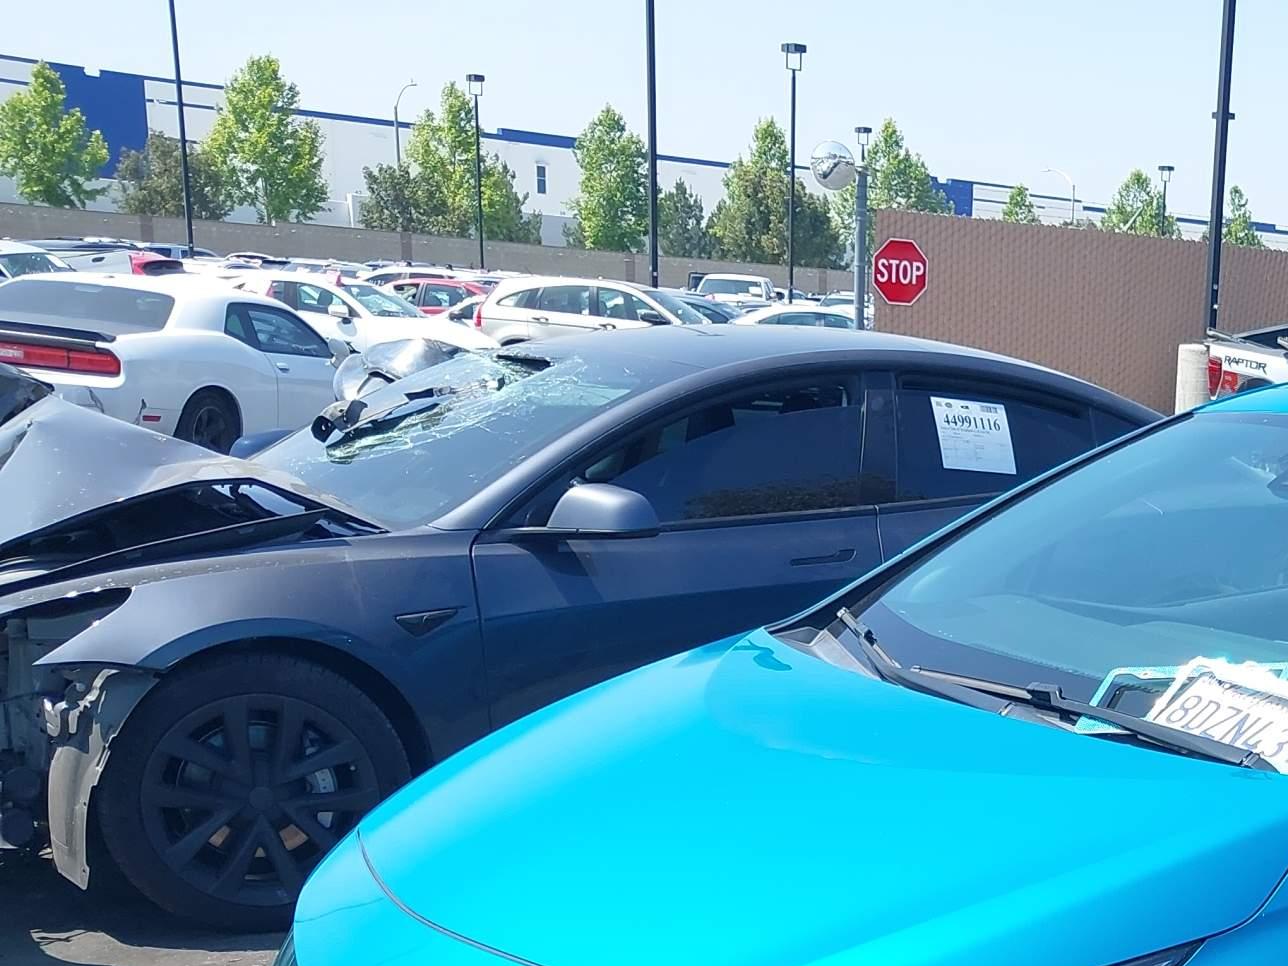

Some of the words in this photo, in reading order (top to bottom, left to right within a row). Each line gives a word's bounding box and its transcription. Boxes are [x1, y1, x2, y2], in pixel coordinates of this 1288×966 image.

[876, 258, 924, 285] STOP
[1224, 355, 1267, 375] RAPTOR
[943, 413, 1001, 432] 44991116
